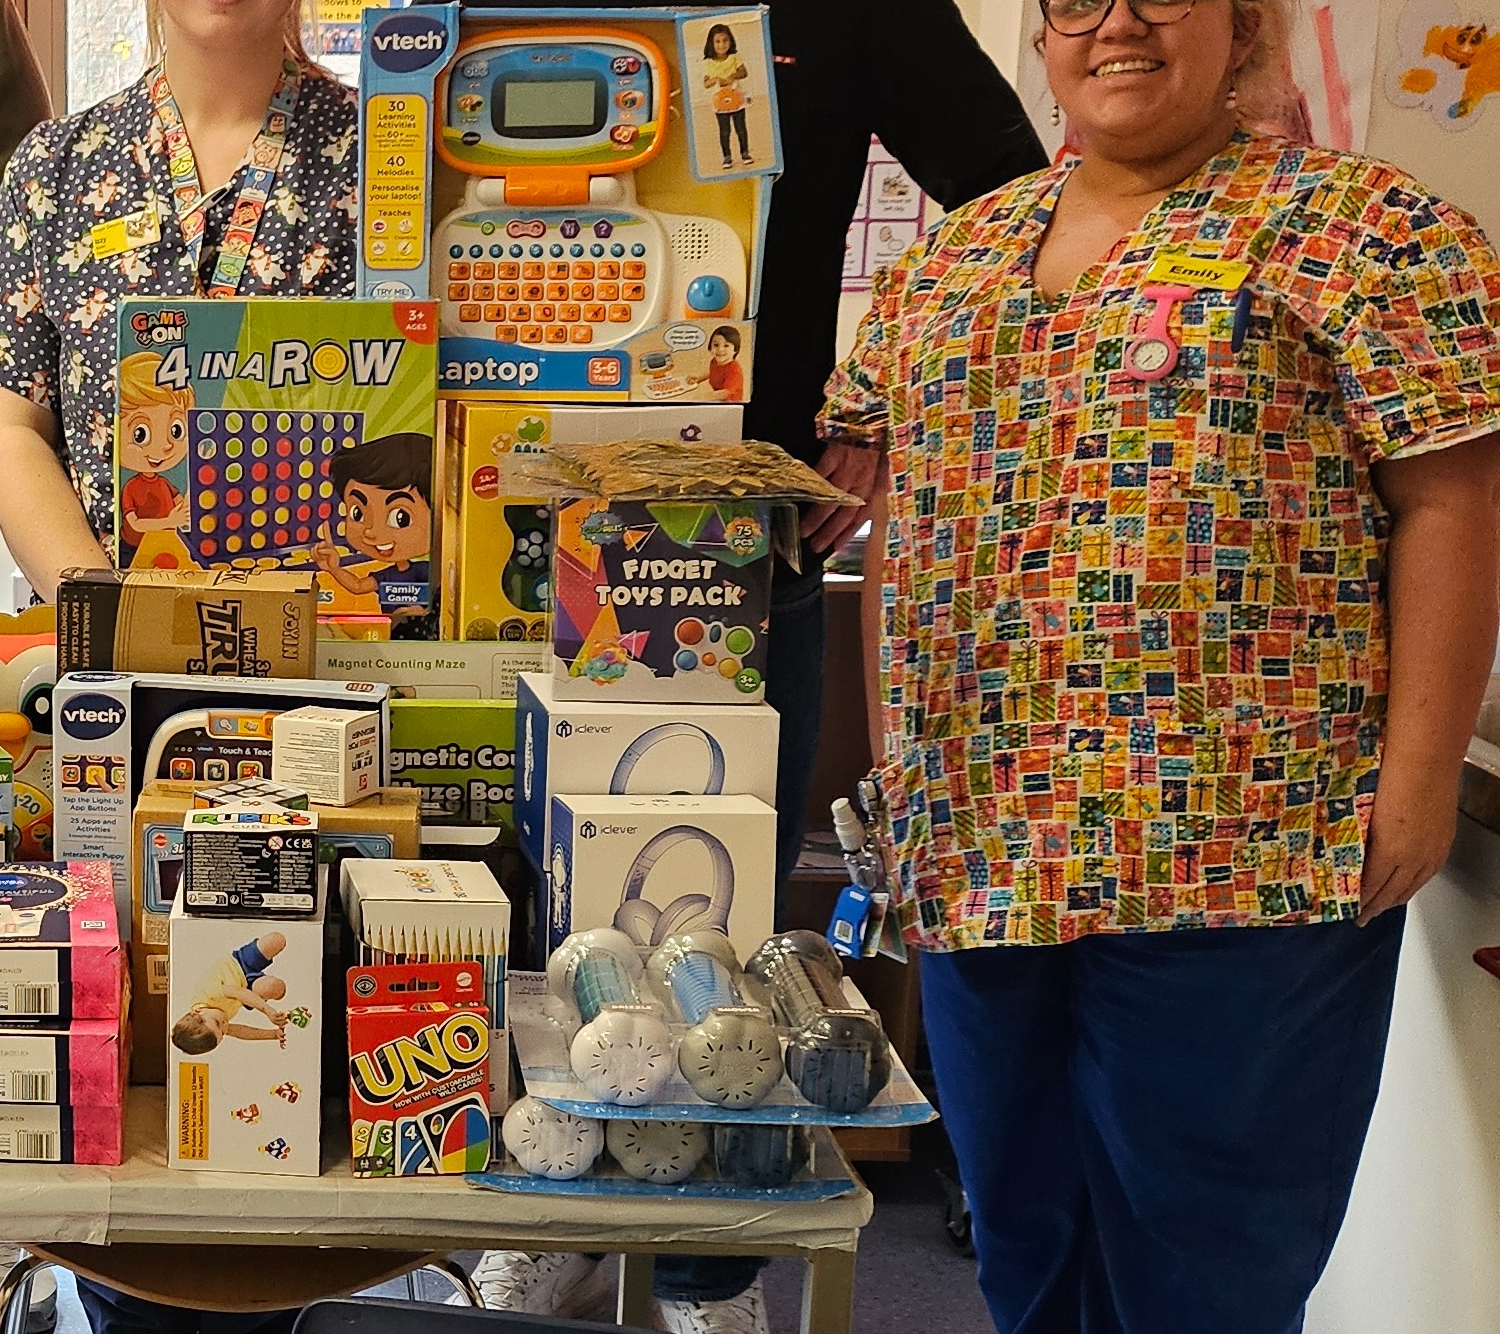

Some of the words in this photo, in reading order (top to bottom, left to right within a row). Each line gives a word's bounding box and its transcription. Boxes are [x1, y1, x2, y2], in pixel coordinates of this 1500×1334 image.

[374, 30, 443, 52] vtech
[388, 101, 406, 112] 30
[378, 112, 416, 122] Learning
[376, 121, 417, 130] Activities
[386, 155, 405, 167] 40
[377, 168, 415, 177] Melodies
[371, 183, 420, 193] Personalise
[369, 194, 389, 202] your
[391, 192, 422, 202] laptop!
[378, 209, 411, 217] Teaches
[1169, 265, 1225, 280] Emily
[376, 288, 392, 297] TRY
[132, 310, 187, 332] GAME
[408, 309, 425, 321] 3+
[405, 323, 427, 331] AGES
[152, 326, 183, 343] ON
[156, 344, 190, 390] 4
[199, 350, 239, 380] IN
[238, 350, 266, 381] A
[269, 338, 406, 389] ROW
[593, 360, 617, 375] 3-6
[440, 357, 540, 387] aptop
[736, 525, 752, 536] 75
[733, 538, 754, 548] PCS
[623, 559, 716, 581] FIDGET
[385, 584, 421, 597] Family
[595, 585, 664, 607] TOYS
[670, 585, 743, 607] PACK
[387, 593, 418, 603] Game
[282, 603, 300, 661] JOYIN
[328, 658, 372, 669] Magnet
[376, 659, 432, 670] Counting
[435, 659, 466, 668] Maze
[64, 708, 123, 724] vtech
[219, 746, 243, 755] Touch
[390, 748, 469, 768] gnetic
[63, 797, 76, 806] Tap
[92, 797, 111, 806] Light
[113, 798, 124, 806] Up
[70, 805, 84, 813] App
[88, 804, 116, 812] Buttons
[81, 818, 100, 827] Apps
[76, 825, 110, 834] Activities
[102, 852, 124, 861] Puppy
[352, 1013, 488, 1101] UNO
[395, 1097, 411, 1108] NOW
[412, 1091, 431, 1102] WITH
[432, 1070, 484, 1094] CUSTOMIZABLE
[439, 1085, 457, 1097] WILD
[458, 1077, 483, 1092] CARDS!
[355, 1127, 369, 1142] 2
[380, 1128, 393, 1144] 3
[405, 1125, 417, 1140] 4
